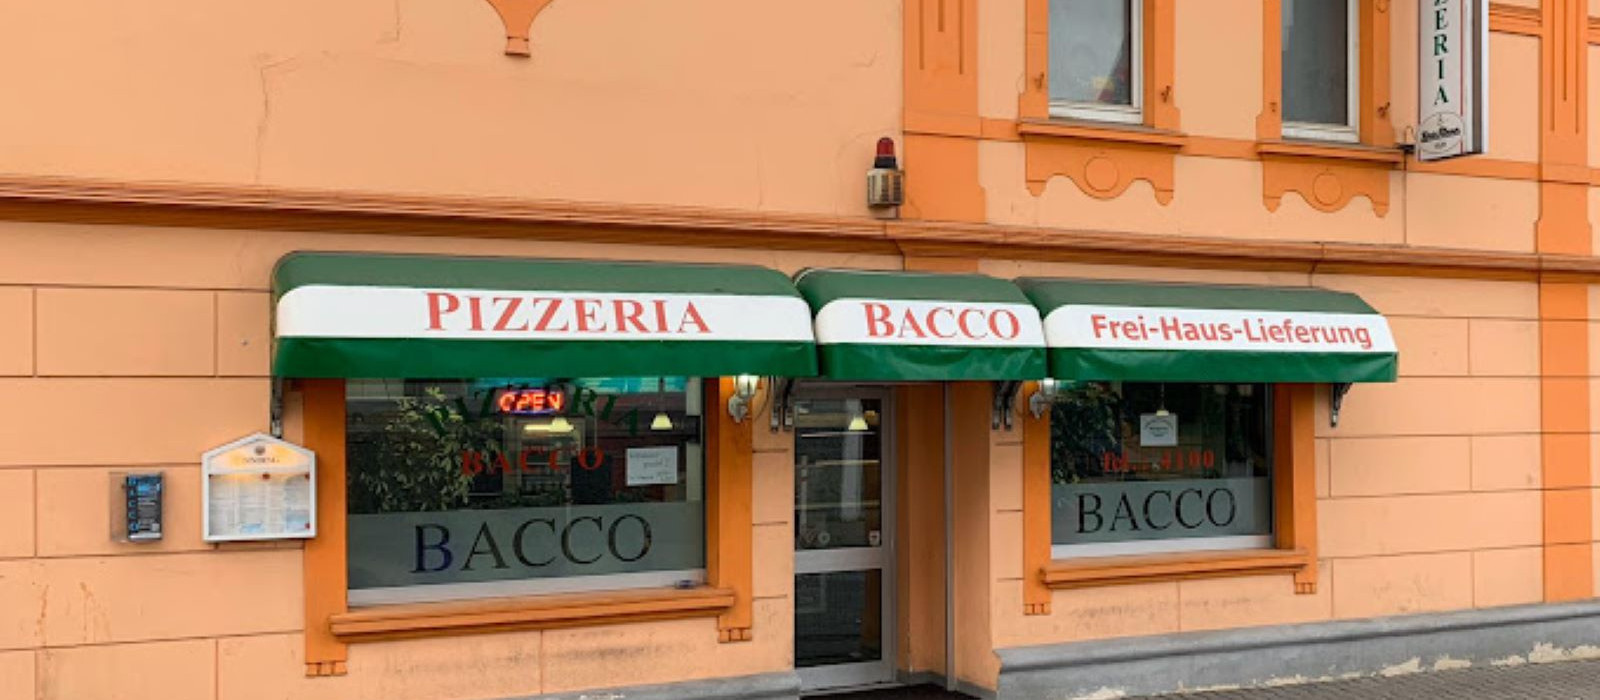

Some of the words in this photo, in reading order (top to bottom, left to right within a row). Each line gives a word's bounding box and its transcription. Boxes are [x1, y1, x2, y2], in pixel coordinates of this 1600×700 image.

[424, 292, 713, 334] PIZZERIA
[863, 302, 1021, 341] BACCO
[1091, 314, 1373, 349] Frei-Haus-Lieferung
[498, 390, 564, 412] OPEN
[460, 446, 605, 477] BACCO
[1075, 488, 1236, 535] BACCO
[409, 513, 652, 574] BACCO
